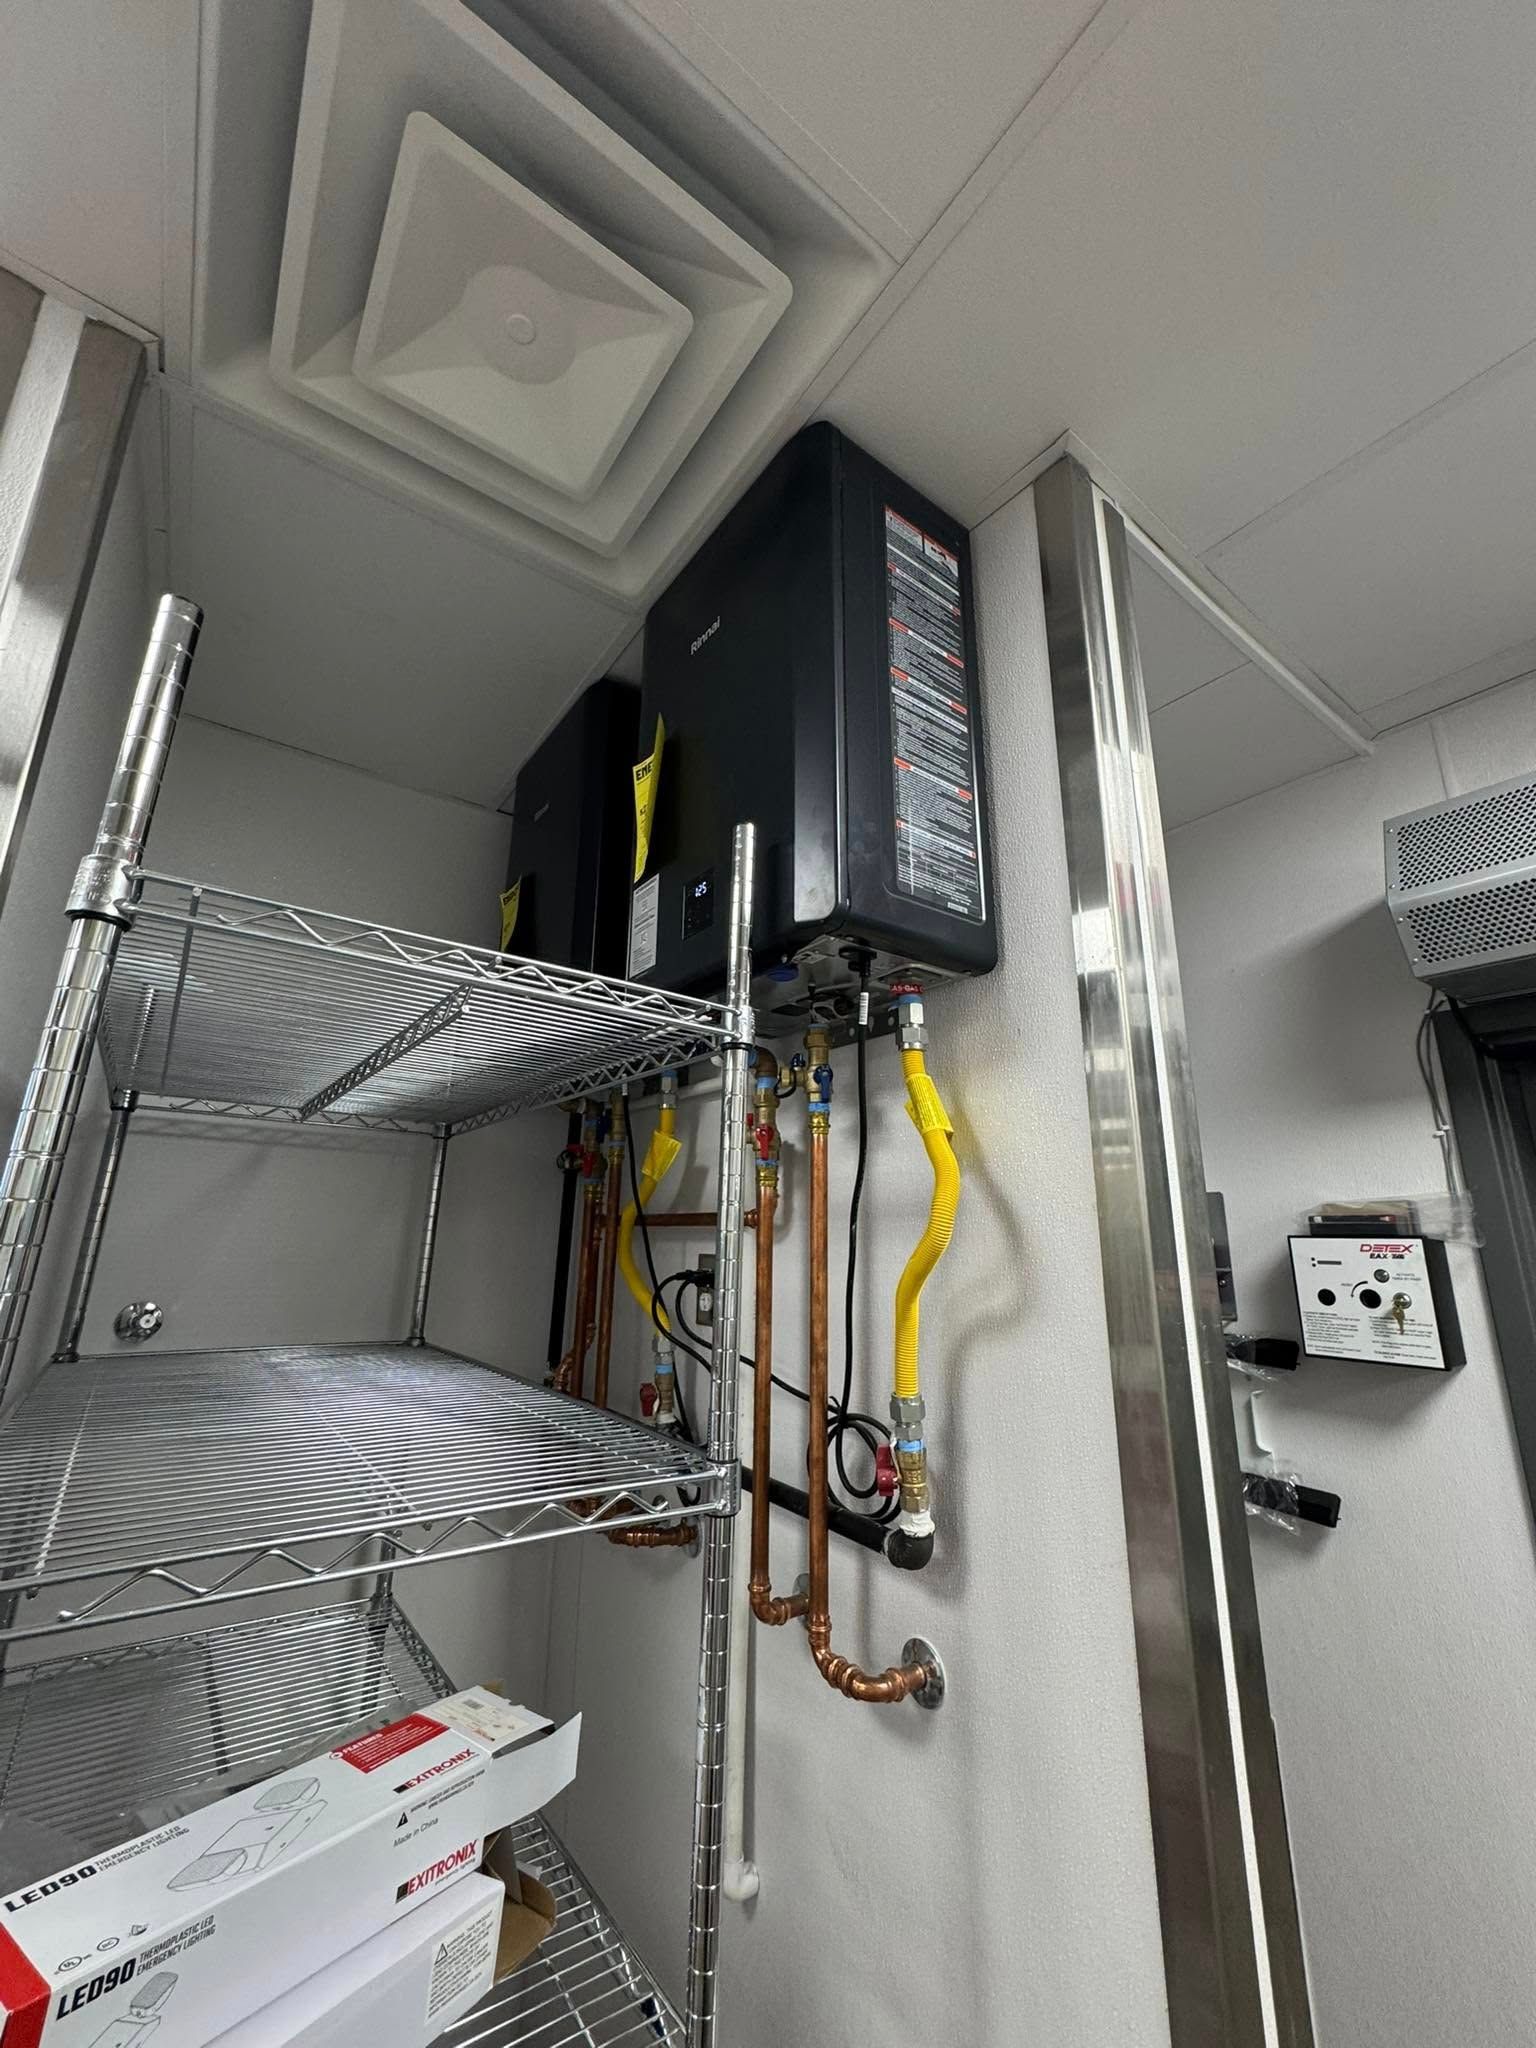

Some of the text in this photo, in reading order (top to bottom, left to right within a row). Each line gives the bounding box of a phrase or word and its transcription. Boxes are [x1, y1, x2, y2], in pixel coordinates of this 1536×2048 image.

[1359, 1243, 1414, 1254] DETEX
[405, 1748, 476, 1788] EXITRONIX
[98, 1827, 190, 1872] EMERGENCY LIGHTING
[393, 1817, 439, 1848] Made in China
[4, 1825, 182, 1913] LED90 THERMOPLASTIC LED
[407, 1838, 479, 1896] EXITRONIX
[55, 1914, 215, 2022] LED90 THERMOPLASTIC LED
[136, 1924, 216, 1977] EMERGENCY LIGHTING
